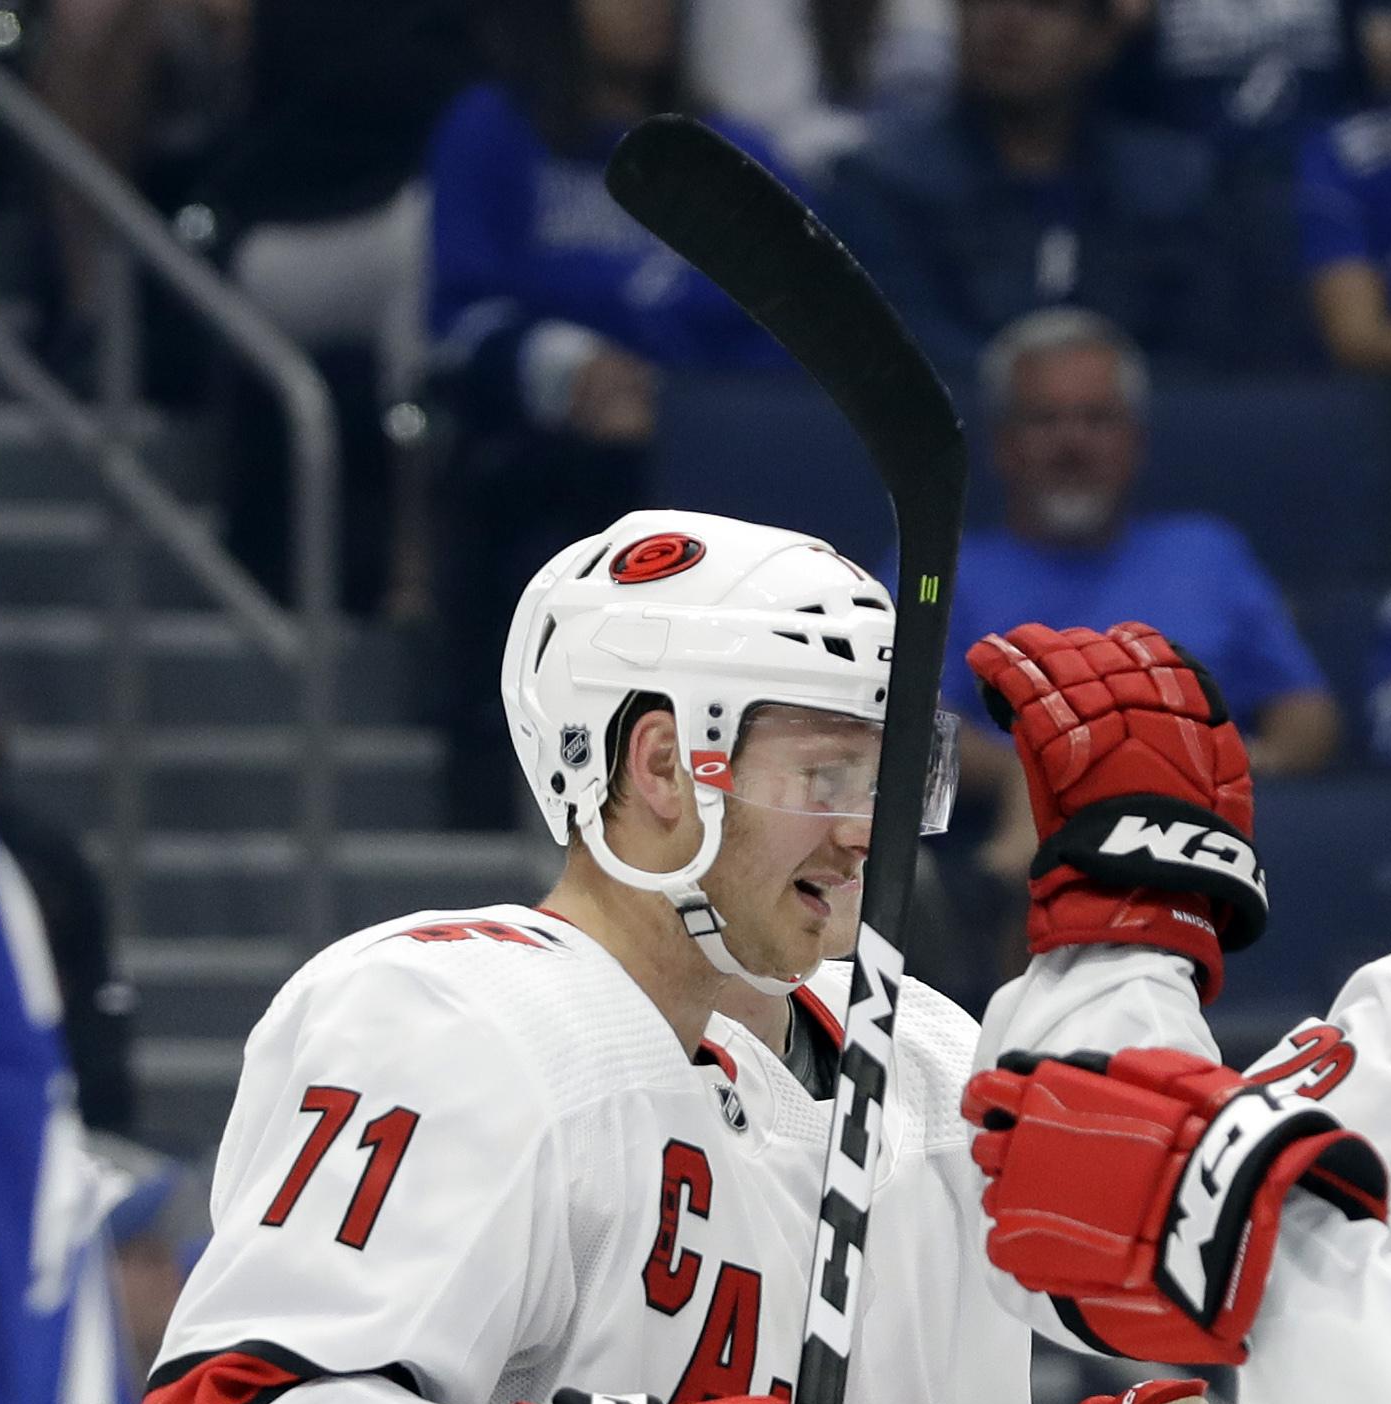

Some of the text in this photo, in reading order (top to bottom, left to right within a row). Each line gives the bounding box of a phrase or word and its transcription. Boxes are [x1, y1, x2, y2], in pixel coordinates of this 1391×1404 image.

[1098, 815, 1270, 912] CM
[260, 1085, 420, 1251] 71
[804, 920, 905, 1358] CCM
